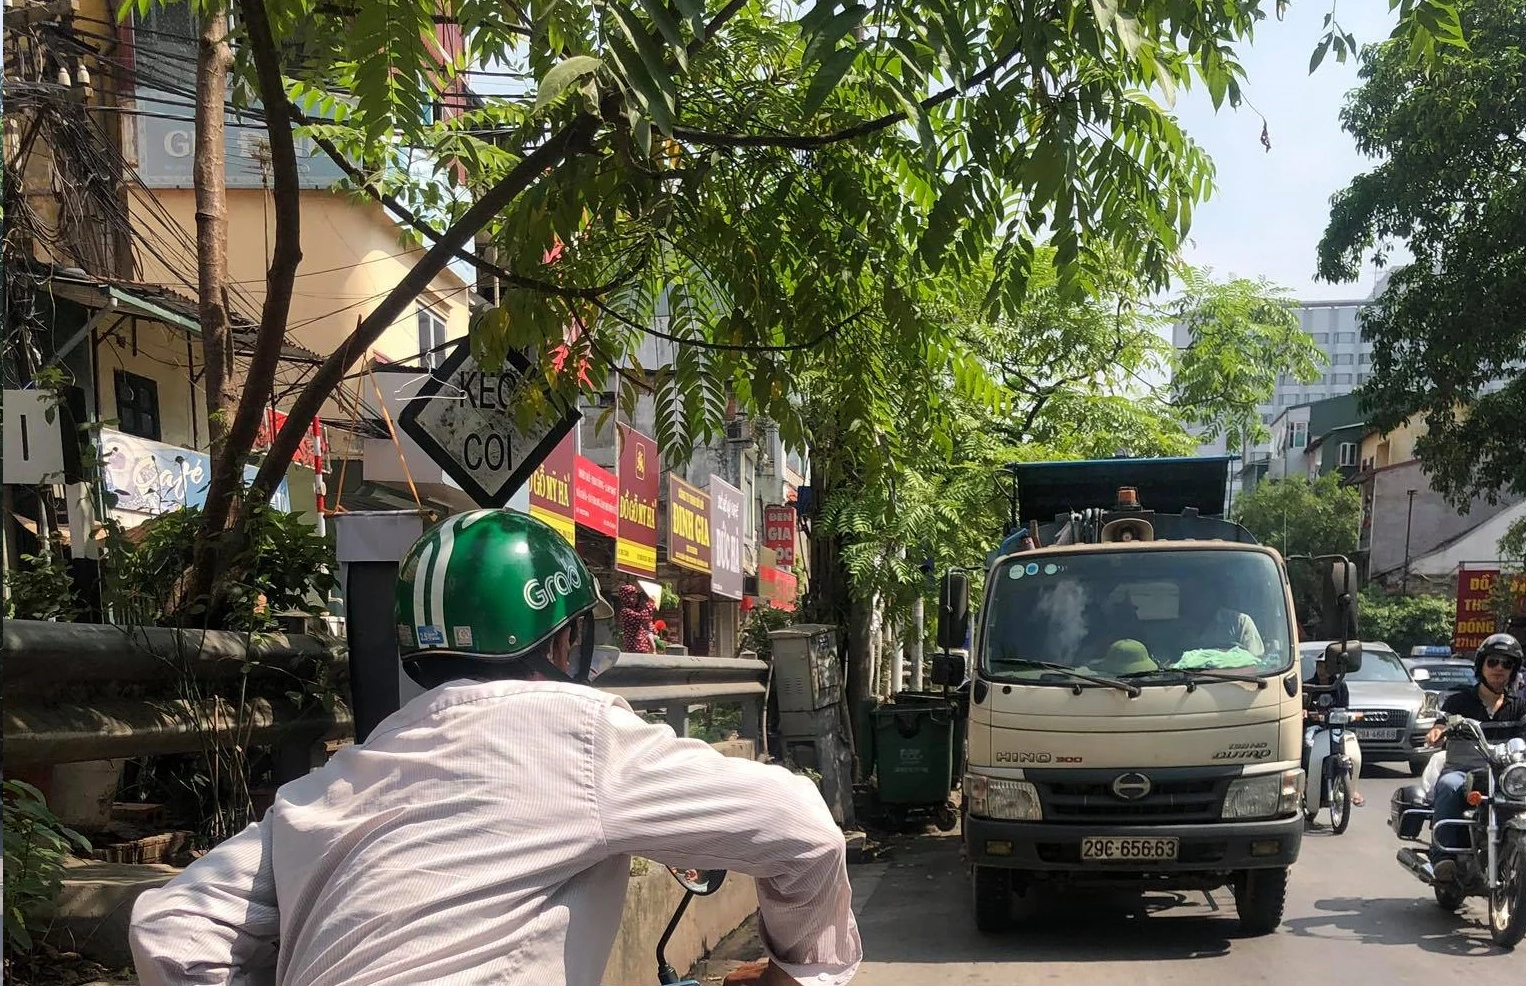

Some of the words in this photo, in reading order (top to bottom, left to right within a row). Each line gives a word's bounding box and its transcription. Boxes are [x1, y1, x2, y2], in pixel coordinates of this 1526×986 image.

[523, 565, 582, 610] Grab
[996, 752, 1052, 763] HINO
[1083, 840, 1175, 857] 29C-656.63
